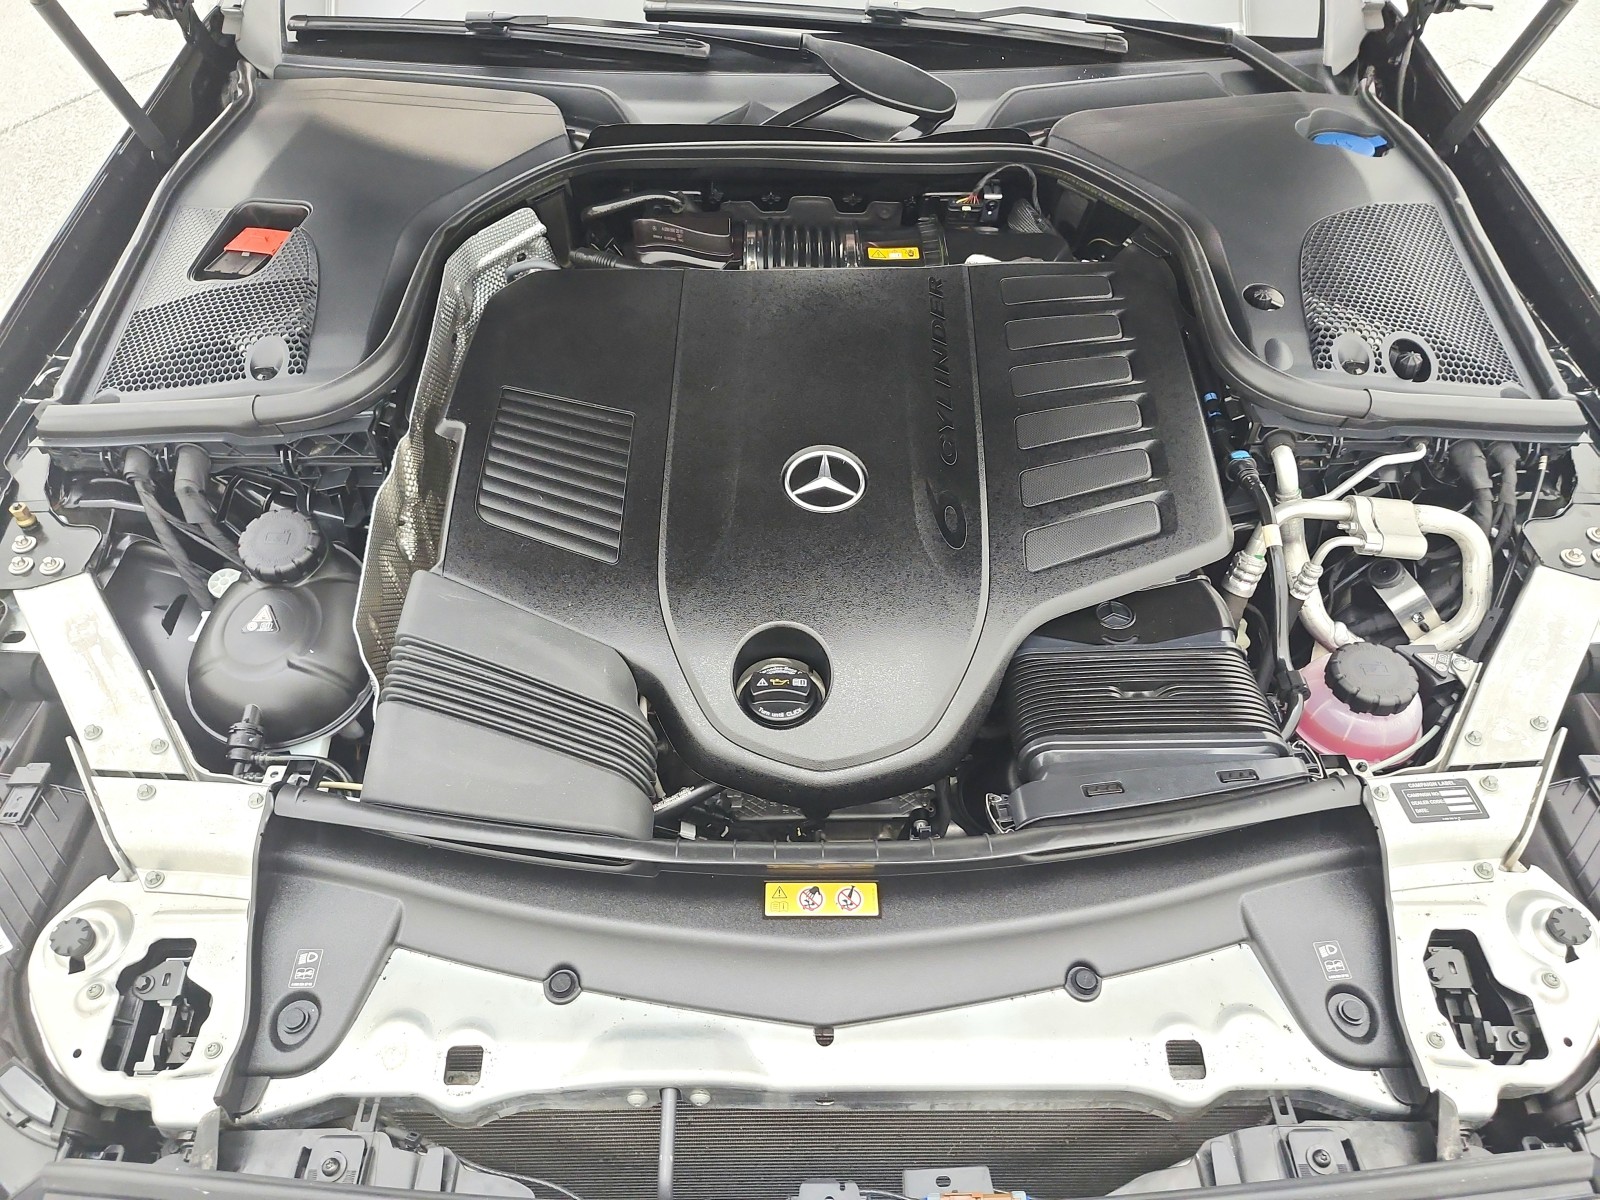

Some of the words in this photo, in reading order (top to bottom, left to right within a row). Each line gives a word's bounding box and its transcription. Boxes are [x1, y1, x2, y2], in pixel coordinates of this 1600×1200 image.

[928, 276, 959, 465] CYLINDER
[758, 706, 771, 716] Turn
[785, 707, 804, 717] CLICK
